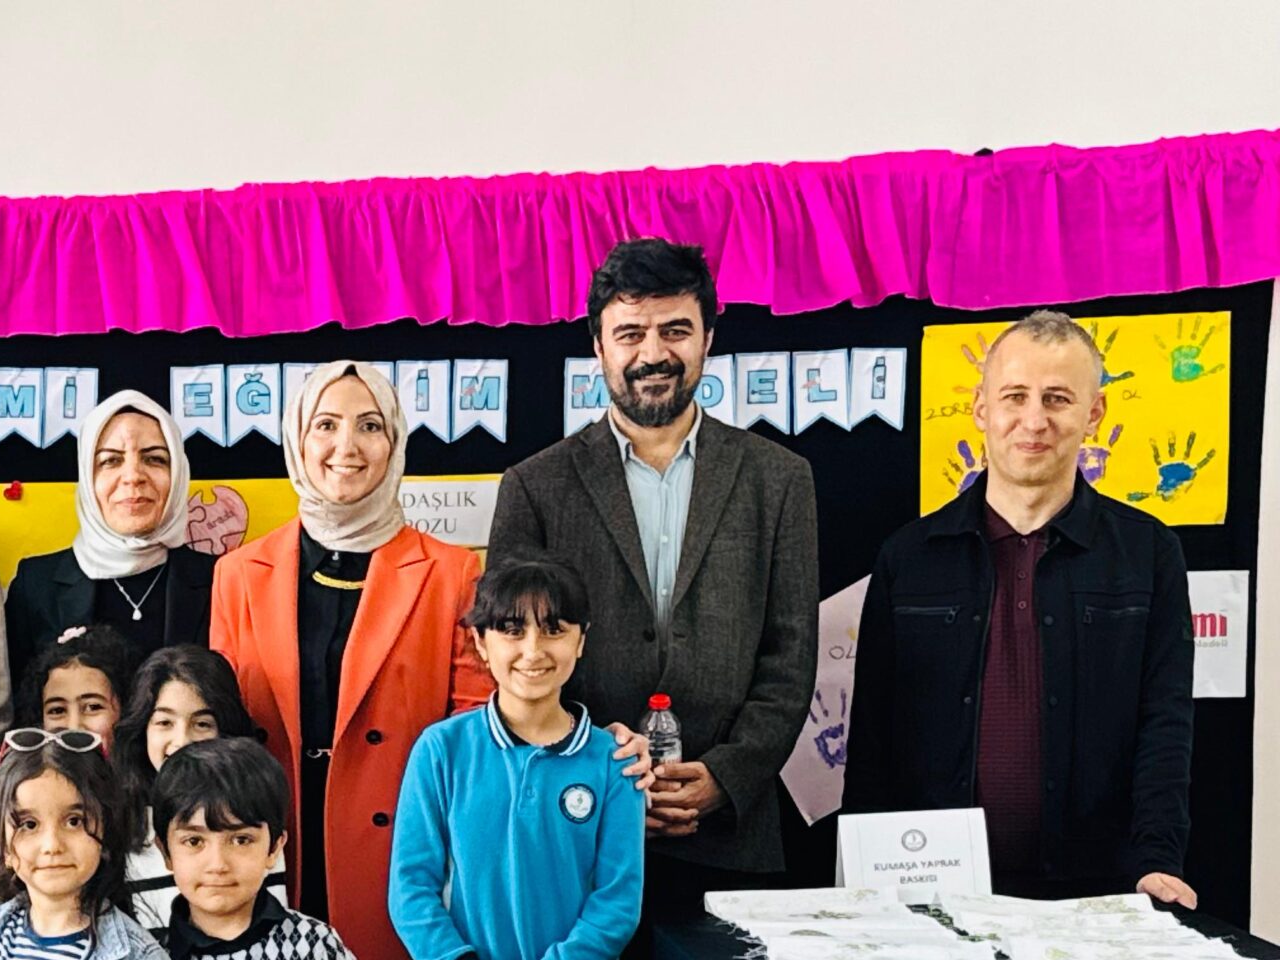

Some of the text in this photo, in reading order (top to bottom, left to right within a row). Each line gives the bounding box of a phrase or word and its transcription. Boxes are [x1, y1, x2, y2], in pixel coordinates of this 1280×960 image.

[183, 369, 500, 418] EĞİM
[571, 356, 887, 409] MDELİ
[401, 491, 477, 512] DAŞLIK
